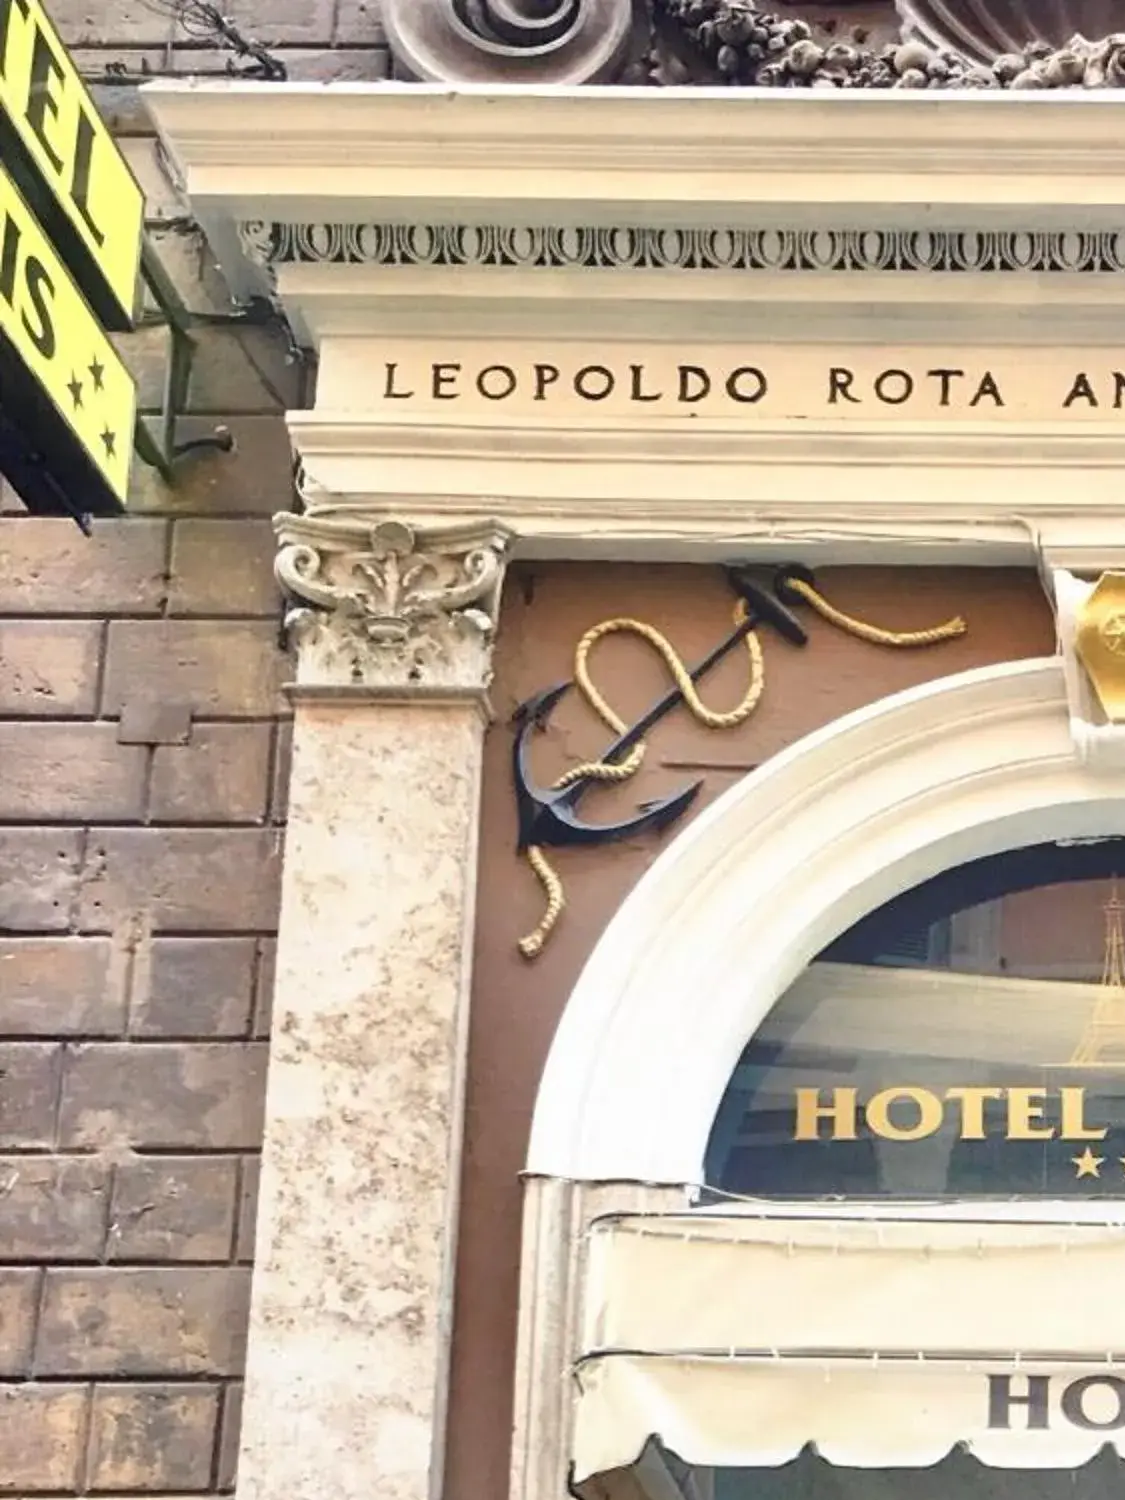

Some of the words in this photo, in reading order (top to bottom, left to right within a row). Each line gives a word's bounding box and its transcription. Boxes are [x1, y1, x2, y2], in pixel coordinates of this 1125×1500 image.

[384, 362, 767, 403] LEOPOLDO
[828, 368, 1005, 407] ROTA
[794, 1087, 1107, 1142] HOTEL
